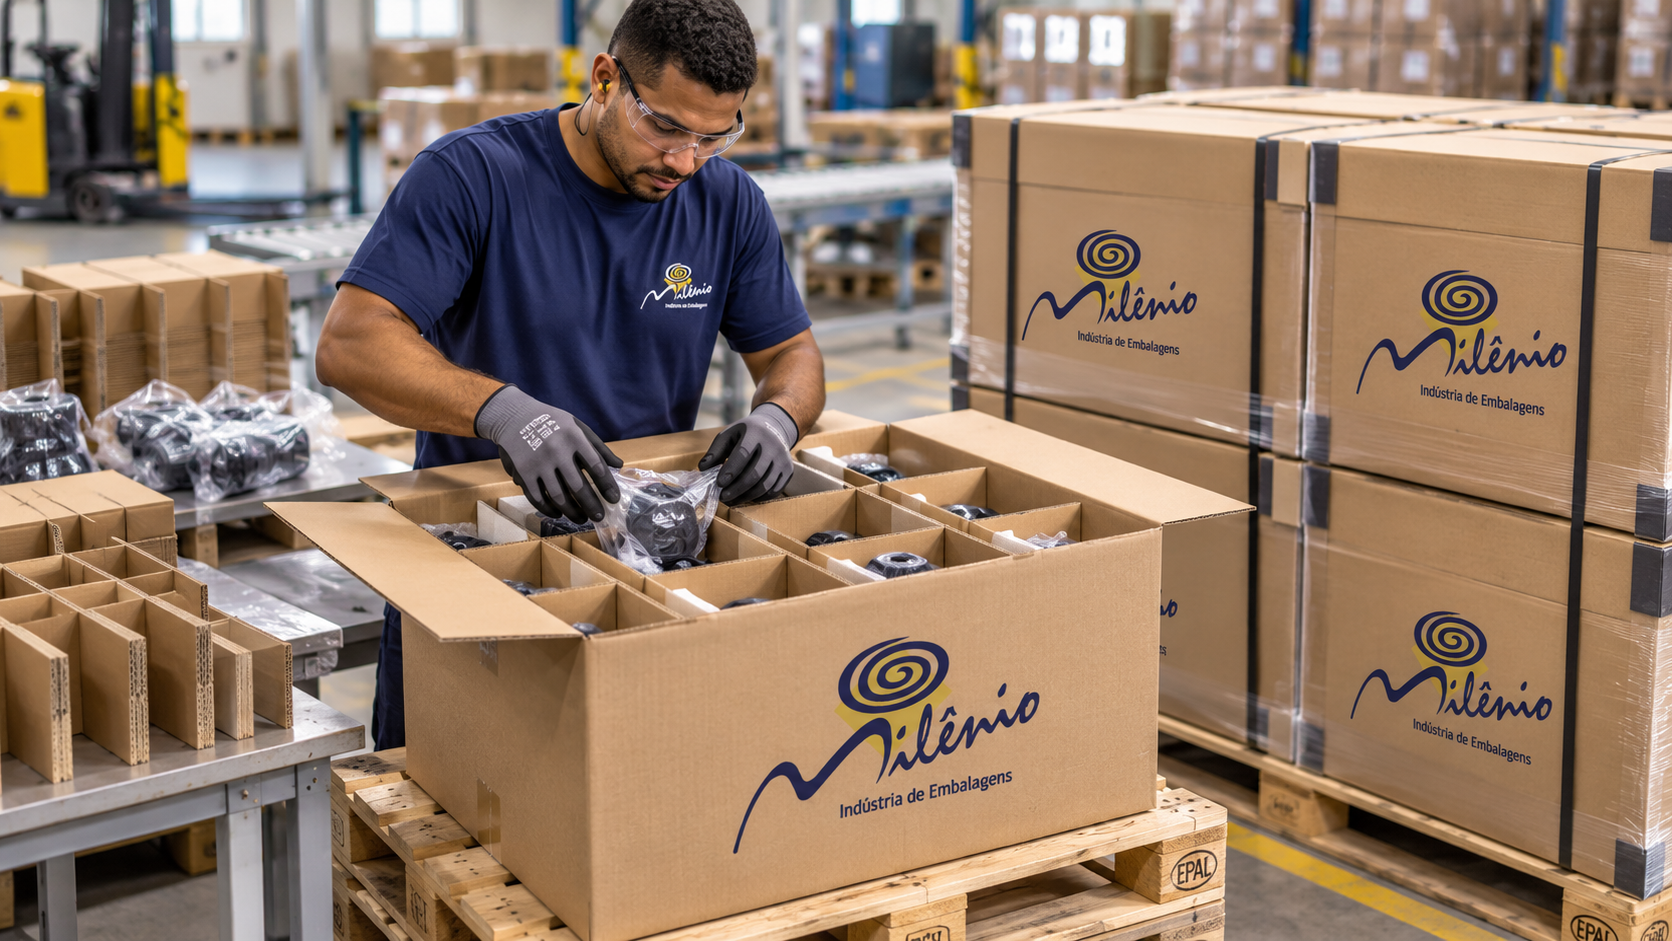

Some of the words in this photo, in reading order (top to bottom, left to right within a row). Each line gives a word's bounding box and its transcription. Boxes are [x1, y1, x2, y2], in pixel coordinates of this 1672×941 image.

[1022, 279, 1198, 341] Milênio
[1077, 330, 1113, 346] Indústria
[1114, 336, 1126, 348] de
[1127, 338, 1181, 356] Embalagens
[1356, 326, 1567, 395] Milênio
[1420, 384, 1464, 402] Indústria
[1465, 391, 1479, 405] de
[1481, 394, 1545, 416] Embalagens
[1350, 666, 1553, 721] Milênio
[1413, 718, 1454, 741] Indústria
[1456, 731, 1469, 746] de
[1471, 736, 1532, 766] Embalagens
[733, 683, 1040, 854] Milênio
[839, 792, 904, 819] Indústria
[907, 788, 925, 804] de
[929, 771, 1013, 799] Embalagens
[1177, 855, 1212, 885] EPAL
